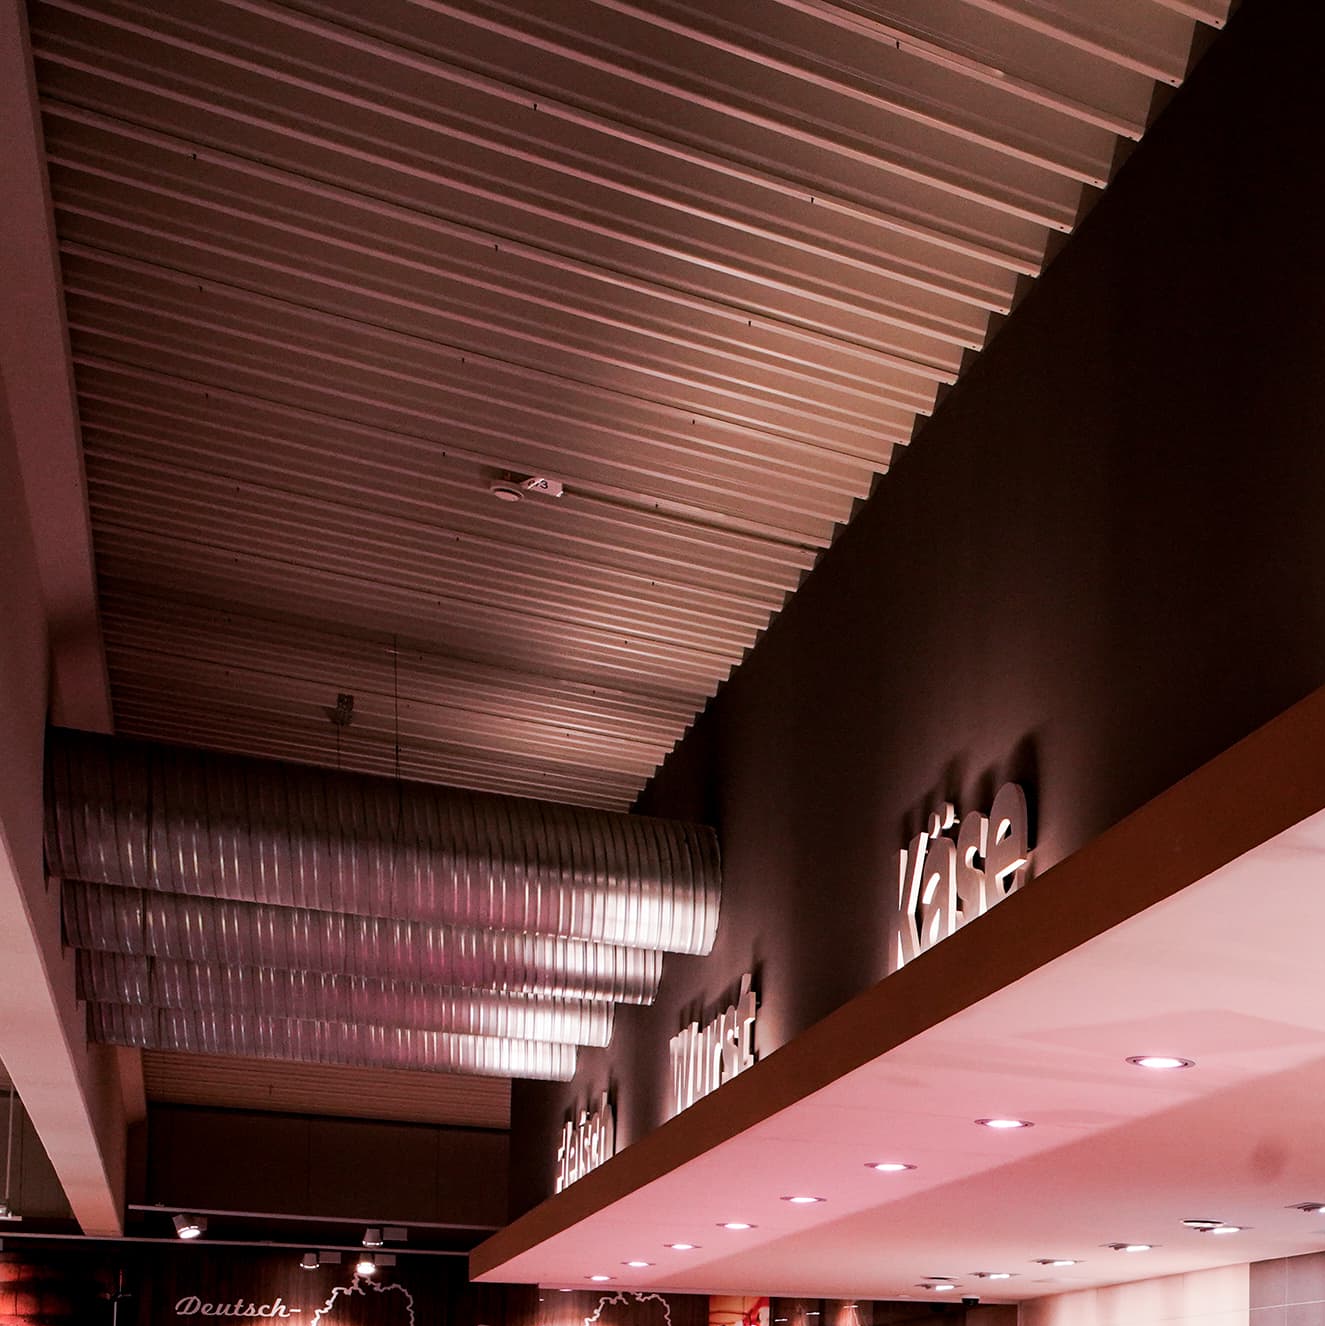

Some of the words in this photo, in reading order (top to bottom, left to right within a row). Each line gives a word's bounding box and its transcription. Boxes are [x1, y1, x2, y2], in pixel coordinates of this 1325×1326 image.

[889, 782, 1035, 972] Käse
[668, 973, 757, 1116] Wurst
[175, 1296, 301, 1317] Deutsch-
